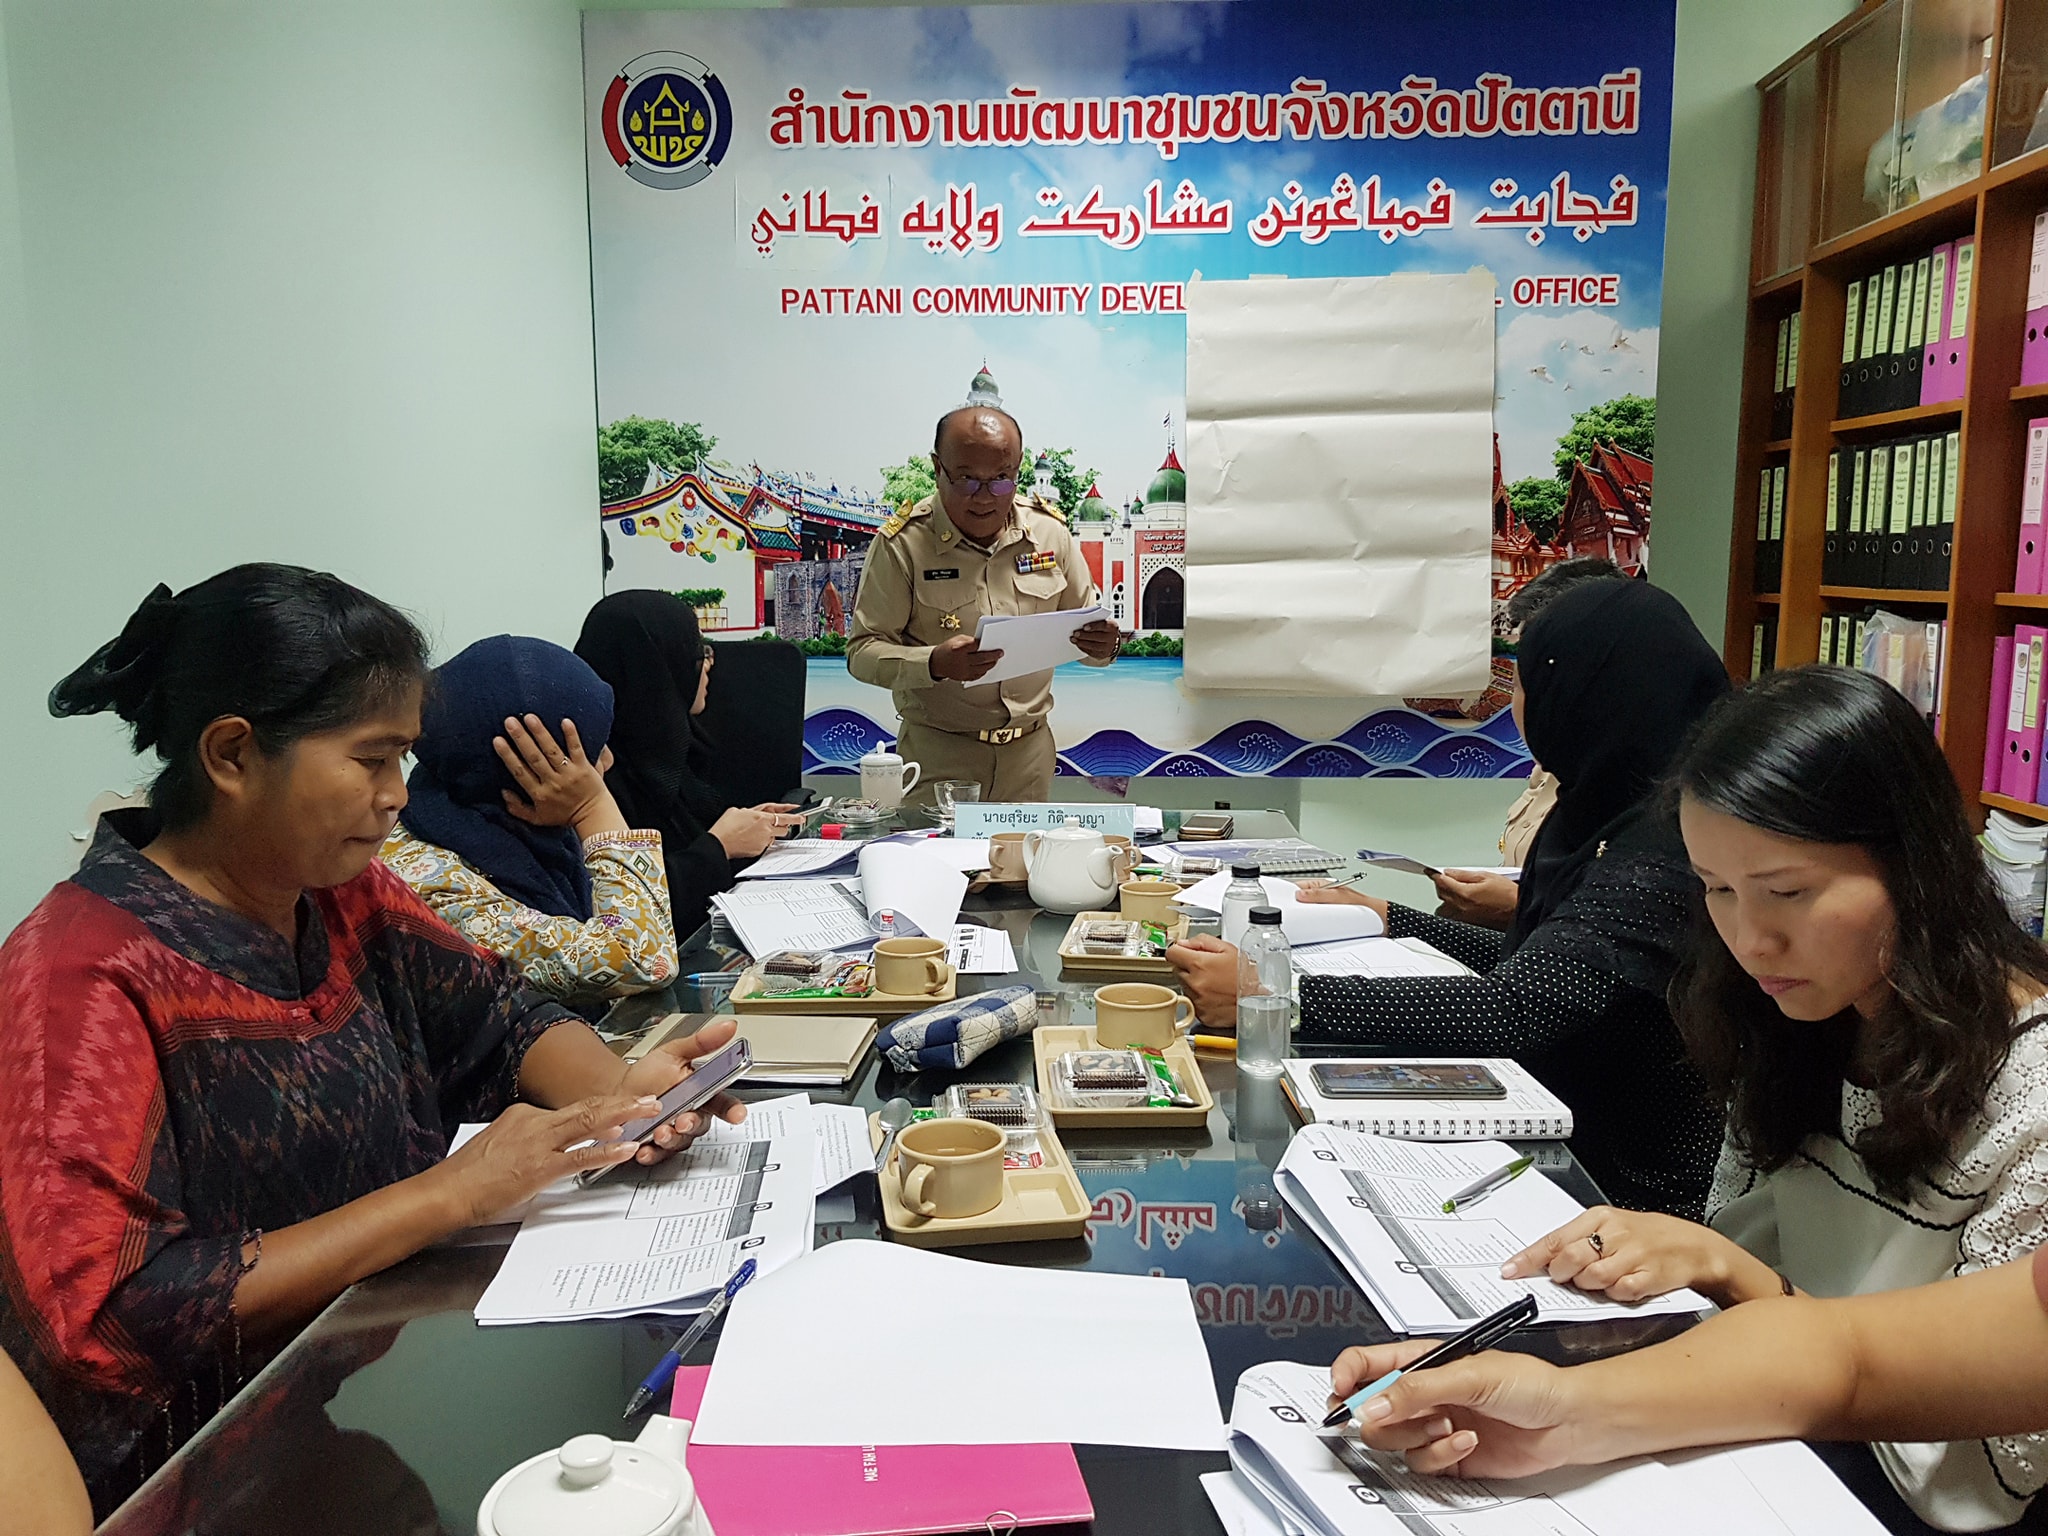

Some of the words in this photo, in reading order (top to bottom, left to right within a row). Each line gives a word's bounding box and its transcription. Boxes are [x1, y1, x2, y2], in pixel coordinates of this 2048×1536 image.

[769, 72, 1638, 155] สำนักงานพัฒนาชุมชนจังหวัดปัตตานี
[781, 287, 901, 314] PATTANI
[912, 285, 1090, 314] COMMUNITY
[1101, 284, 1186, 312] DEVEL
[1512, 276, 1618, 305] OFFICE
[982, 809, 1038, 827] นายสุริยะ
[862, 1452, 877, 1466] FAH
[863, 1466, 879, 1482] MAE
